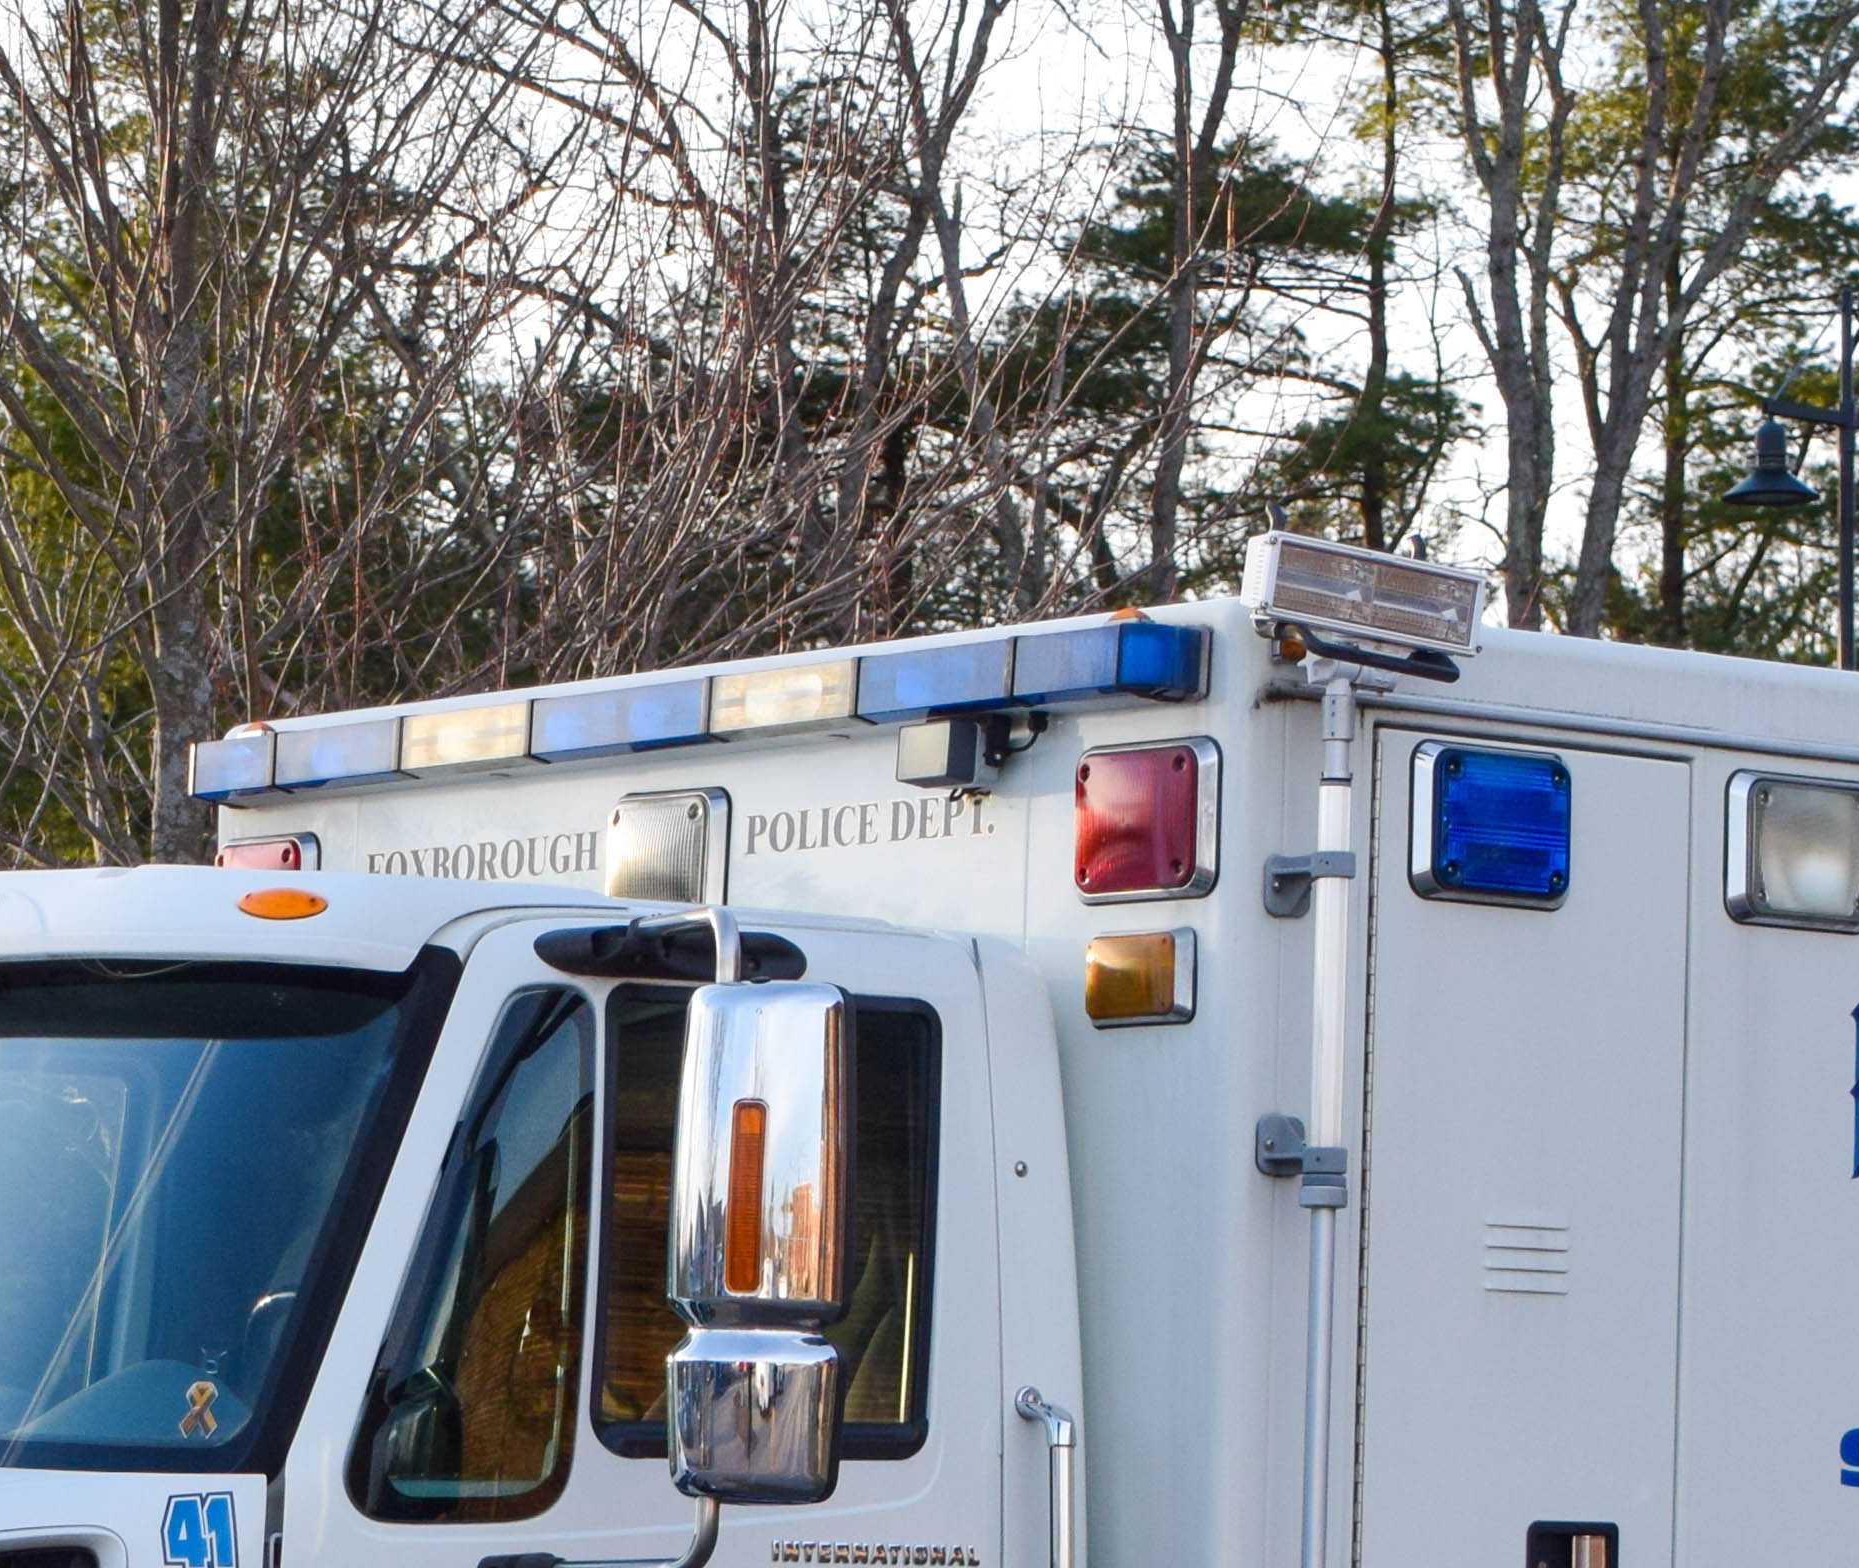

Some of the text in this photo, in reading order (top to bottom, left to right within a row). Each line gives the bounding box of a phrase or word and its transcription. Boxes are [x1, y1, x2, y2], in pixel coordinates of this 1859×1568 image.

[366, 831, 598, 881] FOXBOROUGH
[746, 802, 879, 855] POLICE
[772, 1540, 980, 1567] INTERNATIONAL
